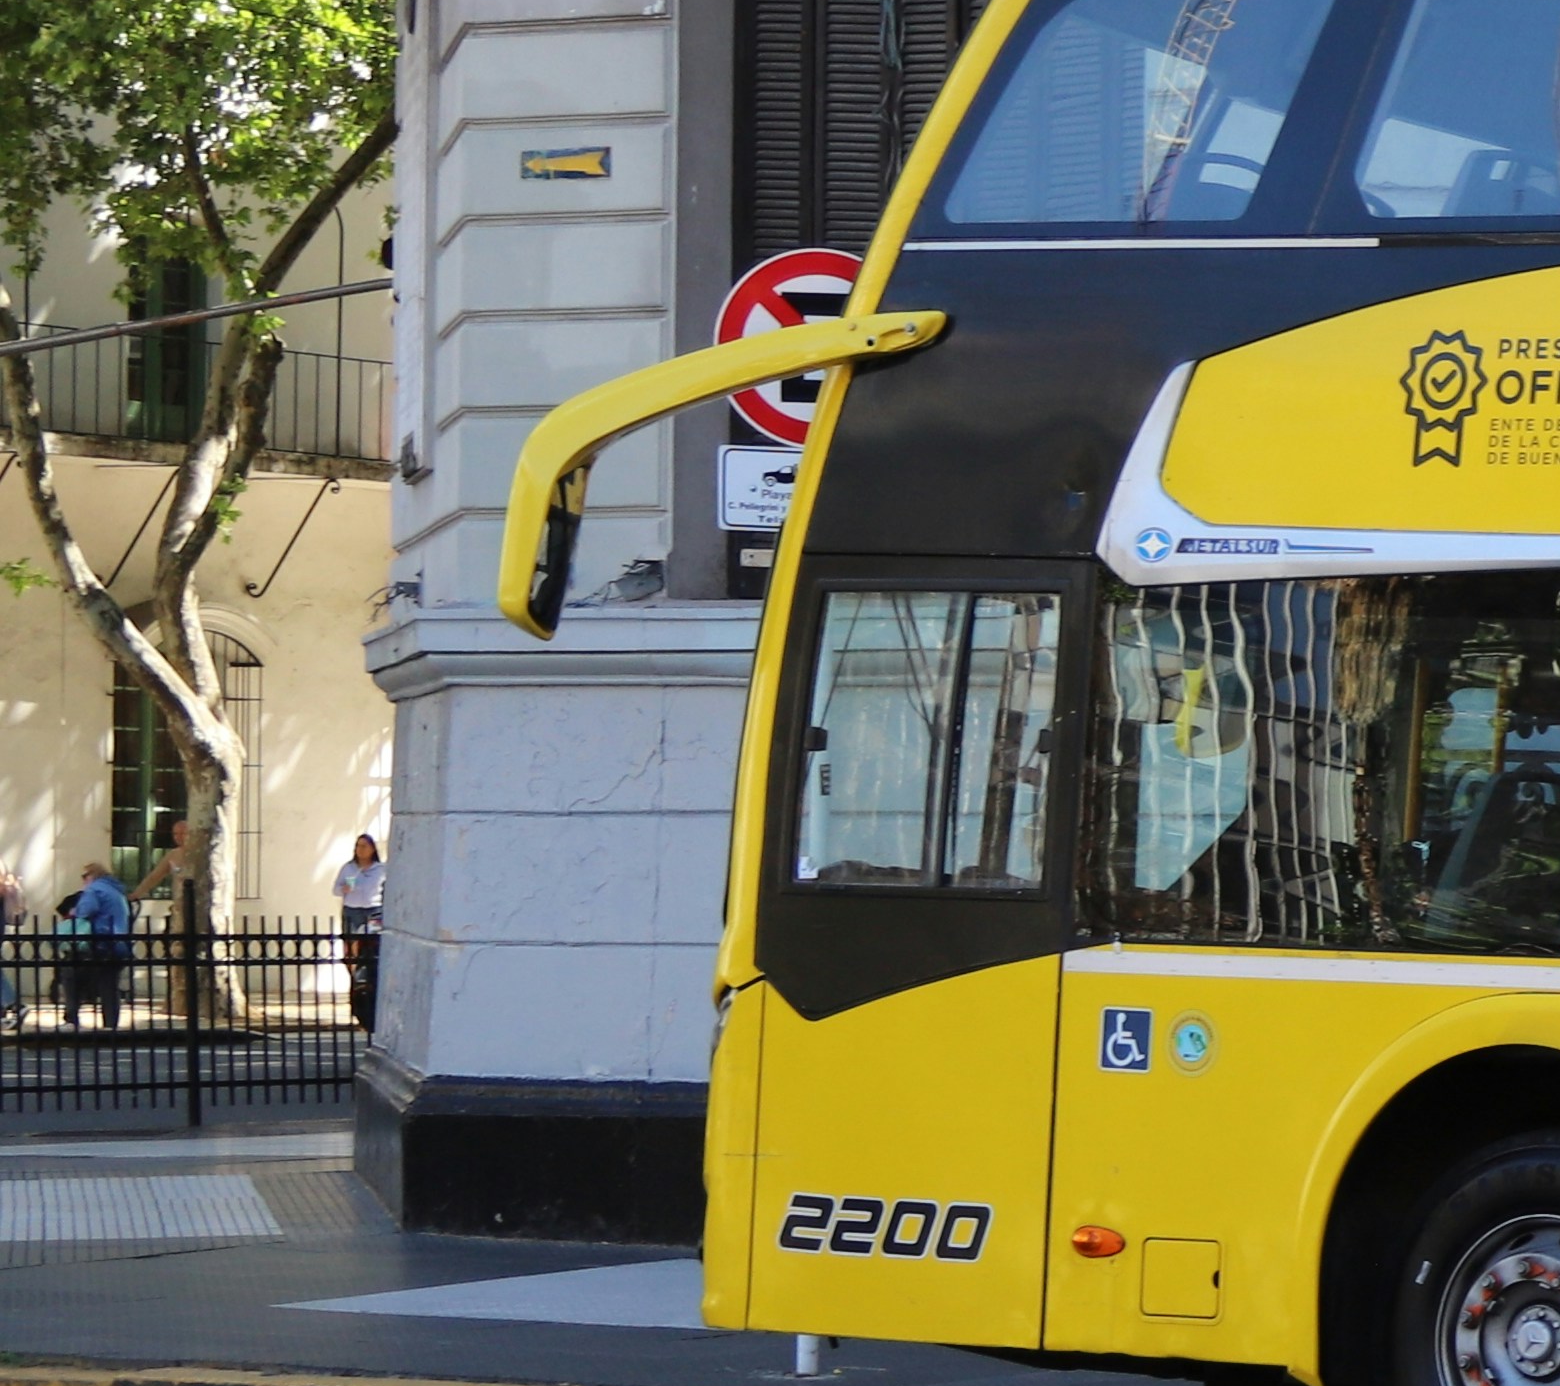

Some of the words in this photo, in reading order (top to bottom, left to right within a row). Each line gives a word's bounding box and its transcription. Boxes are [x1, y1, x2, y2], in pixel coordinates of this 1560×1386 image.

[1490, 418, 1535, 432] ENTE
[1488, 435, 1511, 448] DE
[1519, 435, 1541, 448] LA
[1487, 452, 1510, 465] DE
[1176, 538, 1280, 554] METALSUR
[778, 1192, 993, 1262] 2200
